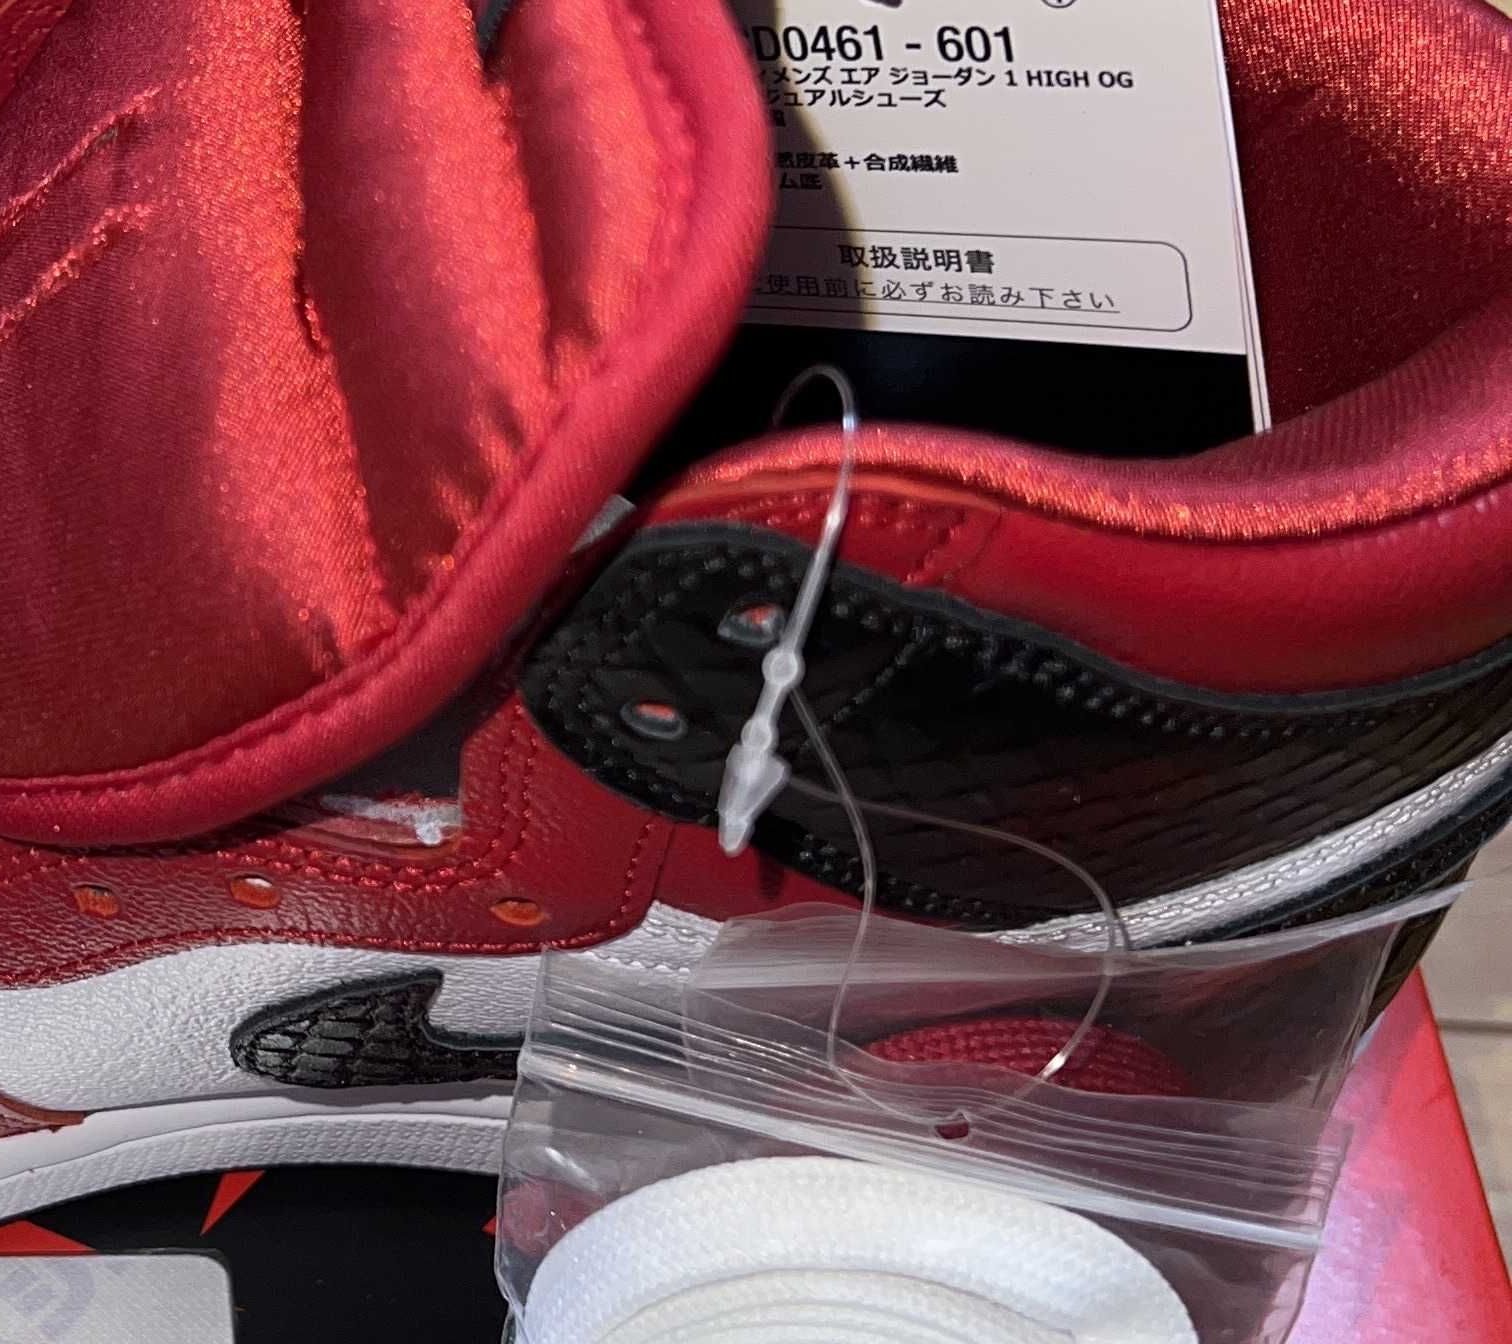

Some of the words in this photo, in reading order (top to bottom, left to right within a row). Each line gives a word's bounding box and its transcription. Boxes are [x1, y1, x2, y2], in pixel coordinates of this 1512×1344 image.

[745, 25, 882, 63] D0461
[936, 26, 1016, 63] 601
[840, 67, 880, 85] エア
[890, 67, 995, 87] ジョーダン
[1027, 70, 1090, 88] HIGH
[1098, 71, 1135, 89] OG
[838, 244, 996, 275] 取扱説明書
